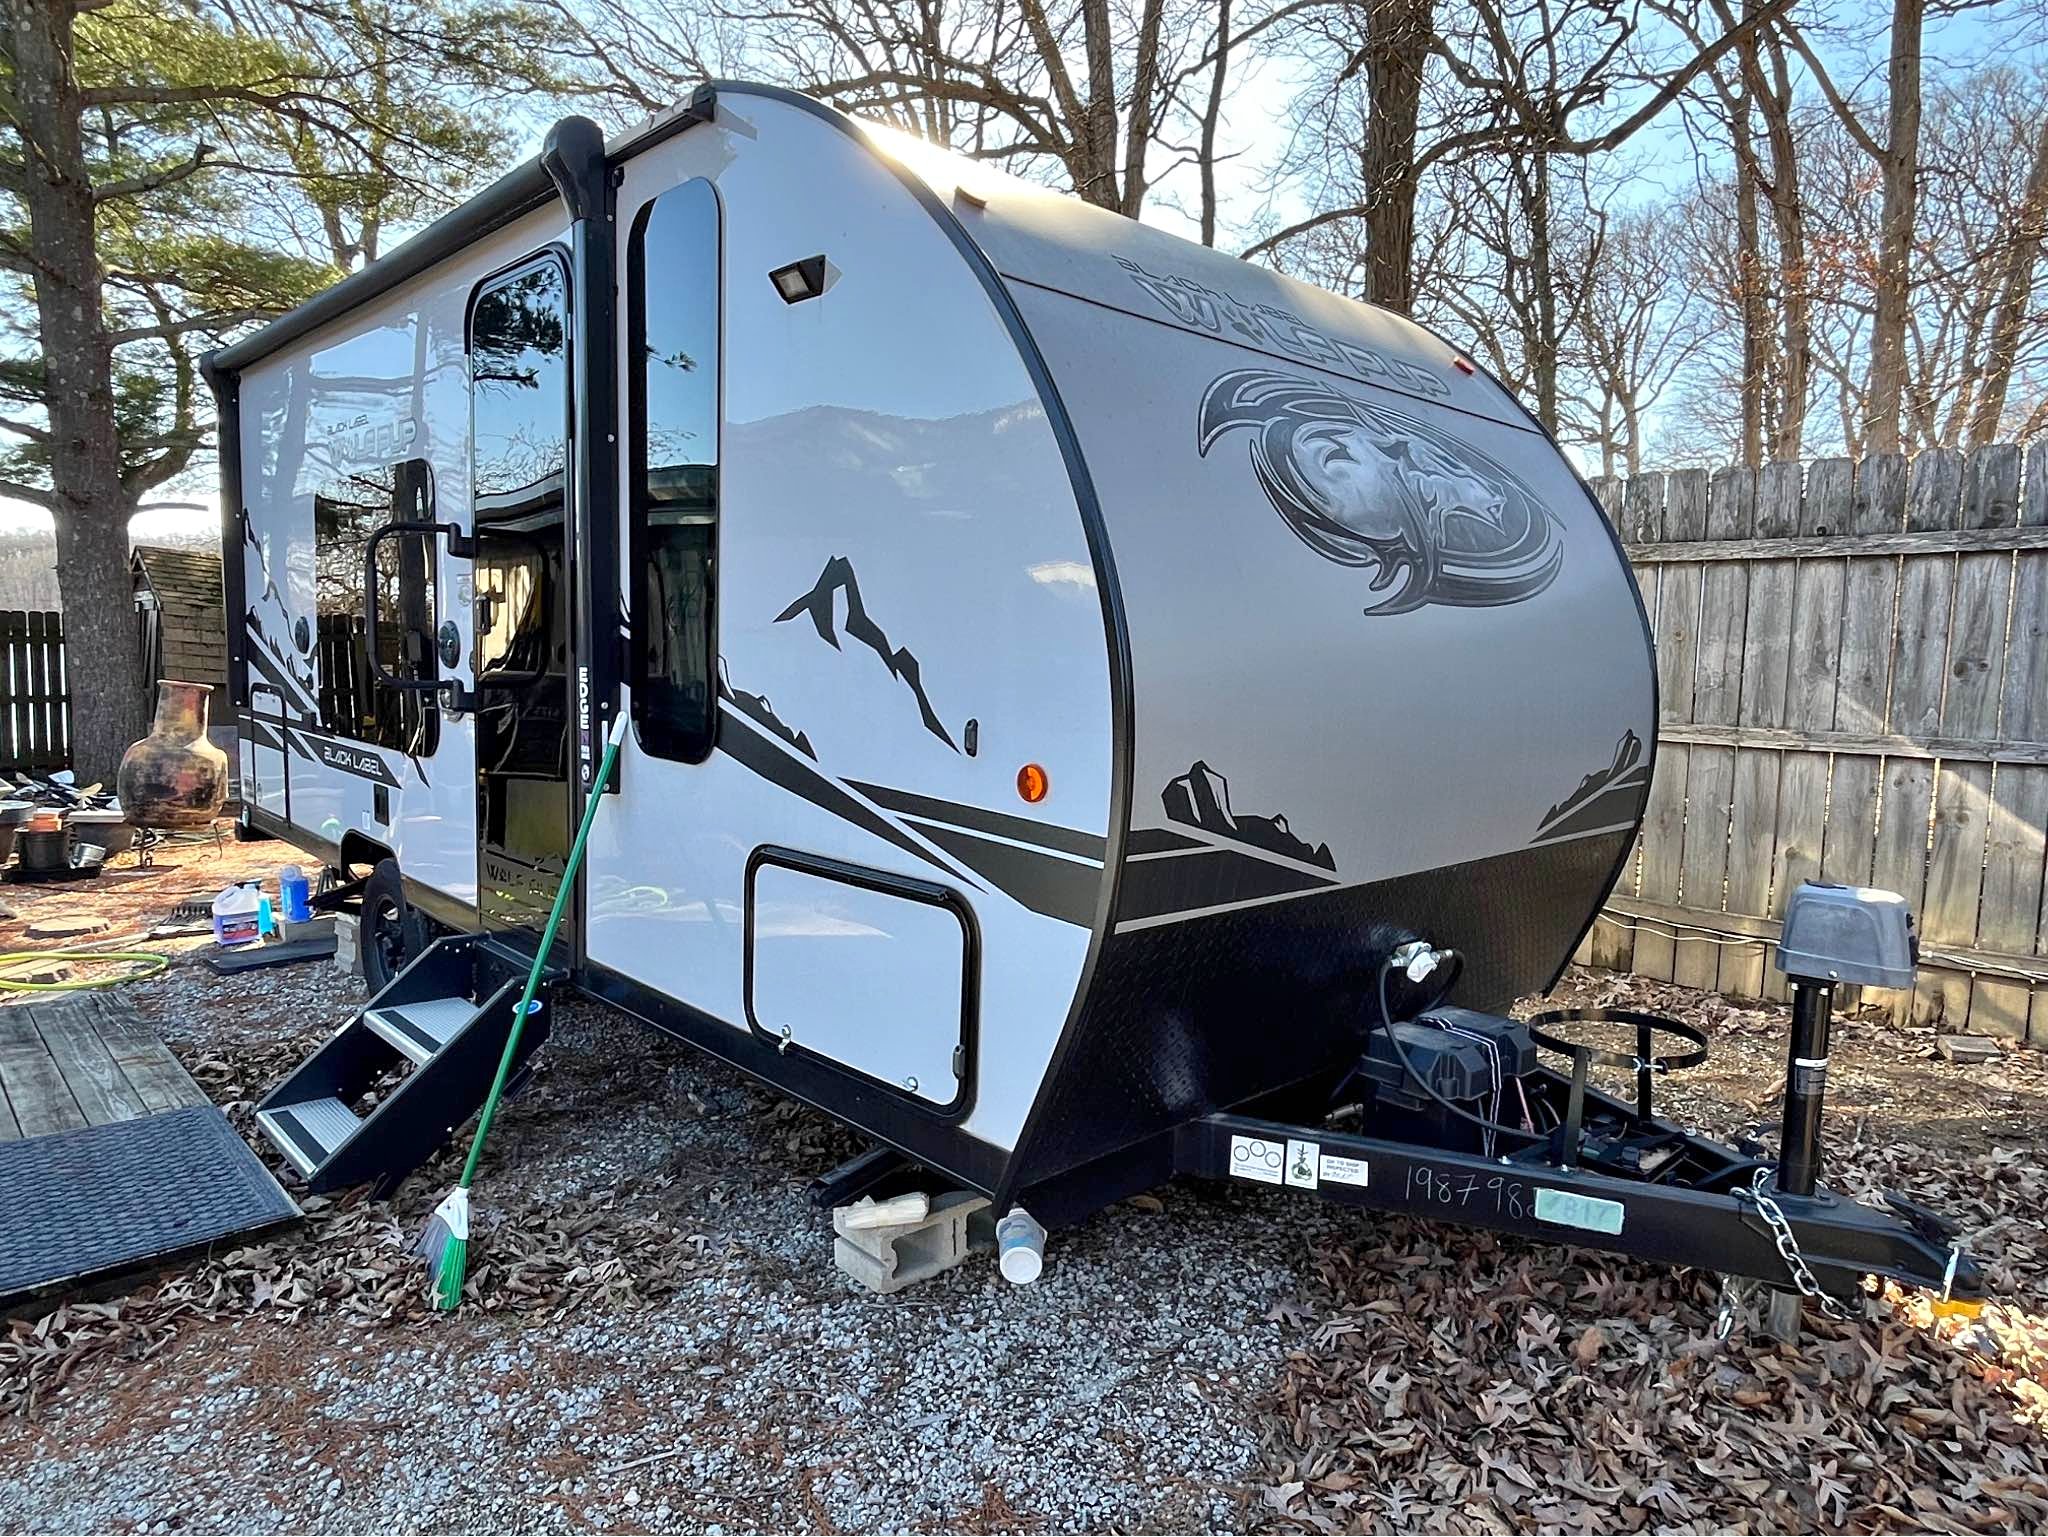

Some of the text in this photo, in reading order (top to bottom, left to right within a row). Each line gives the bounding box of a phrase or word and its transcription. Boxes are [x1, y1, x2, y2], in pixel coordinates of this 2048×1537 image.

[1111, 254, 1317, 332] BLACK LABEL
[579, 666, 590, 730] EDGE
[323, 745, 383, 777] BLACK LABEL
